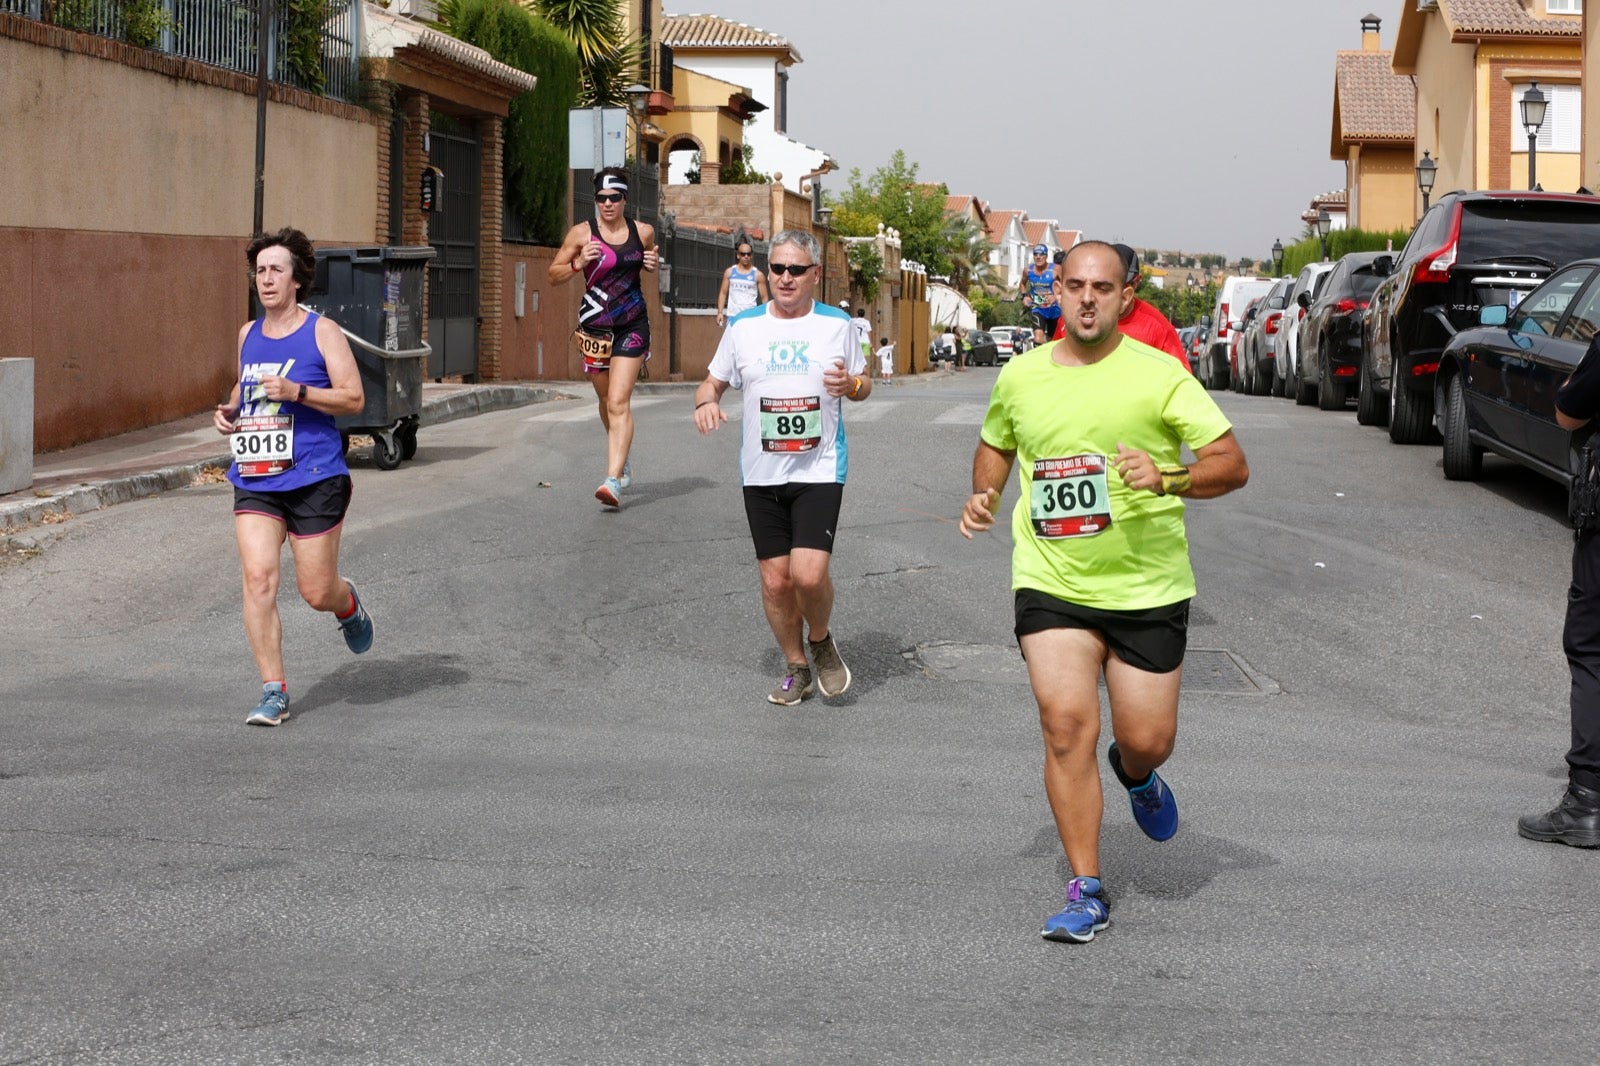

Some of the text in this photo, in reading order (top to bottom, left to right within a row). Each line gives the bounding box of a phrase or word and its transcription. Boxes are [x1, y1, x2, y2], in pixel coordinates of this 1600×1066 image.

[777, 415, 806, 435] 89
[236, 433, 287, 455] 3018
[1043, 480, 1096, 513] 360
